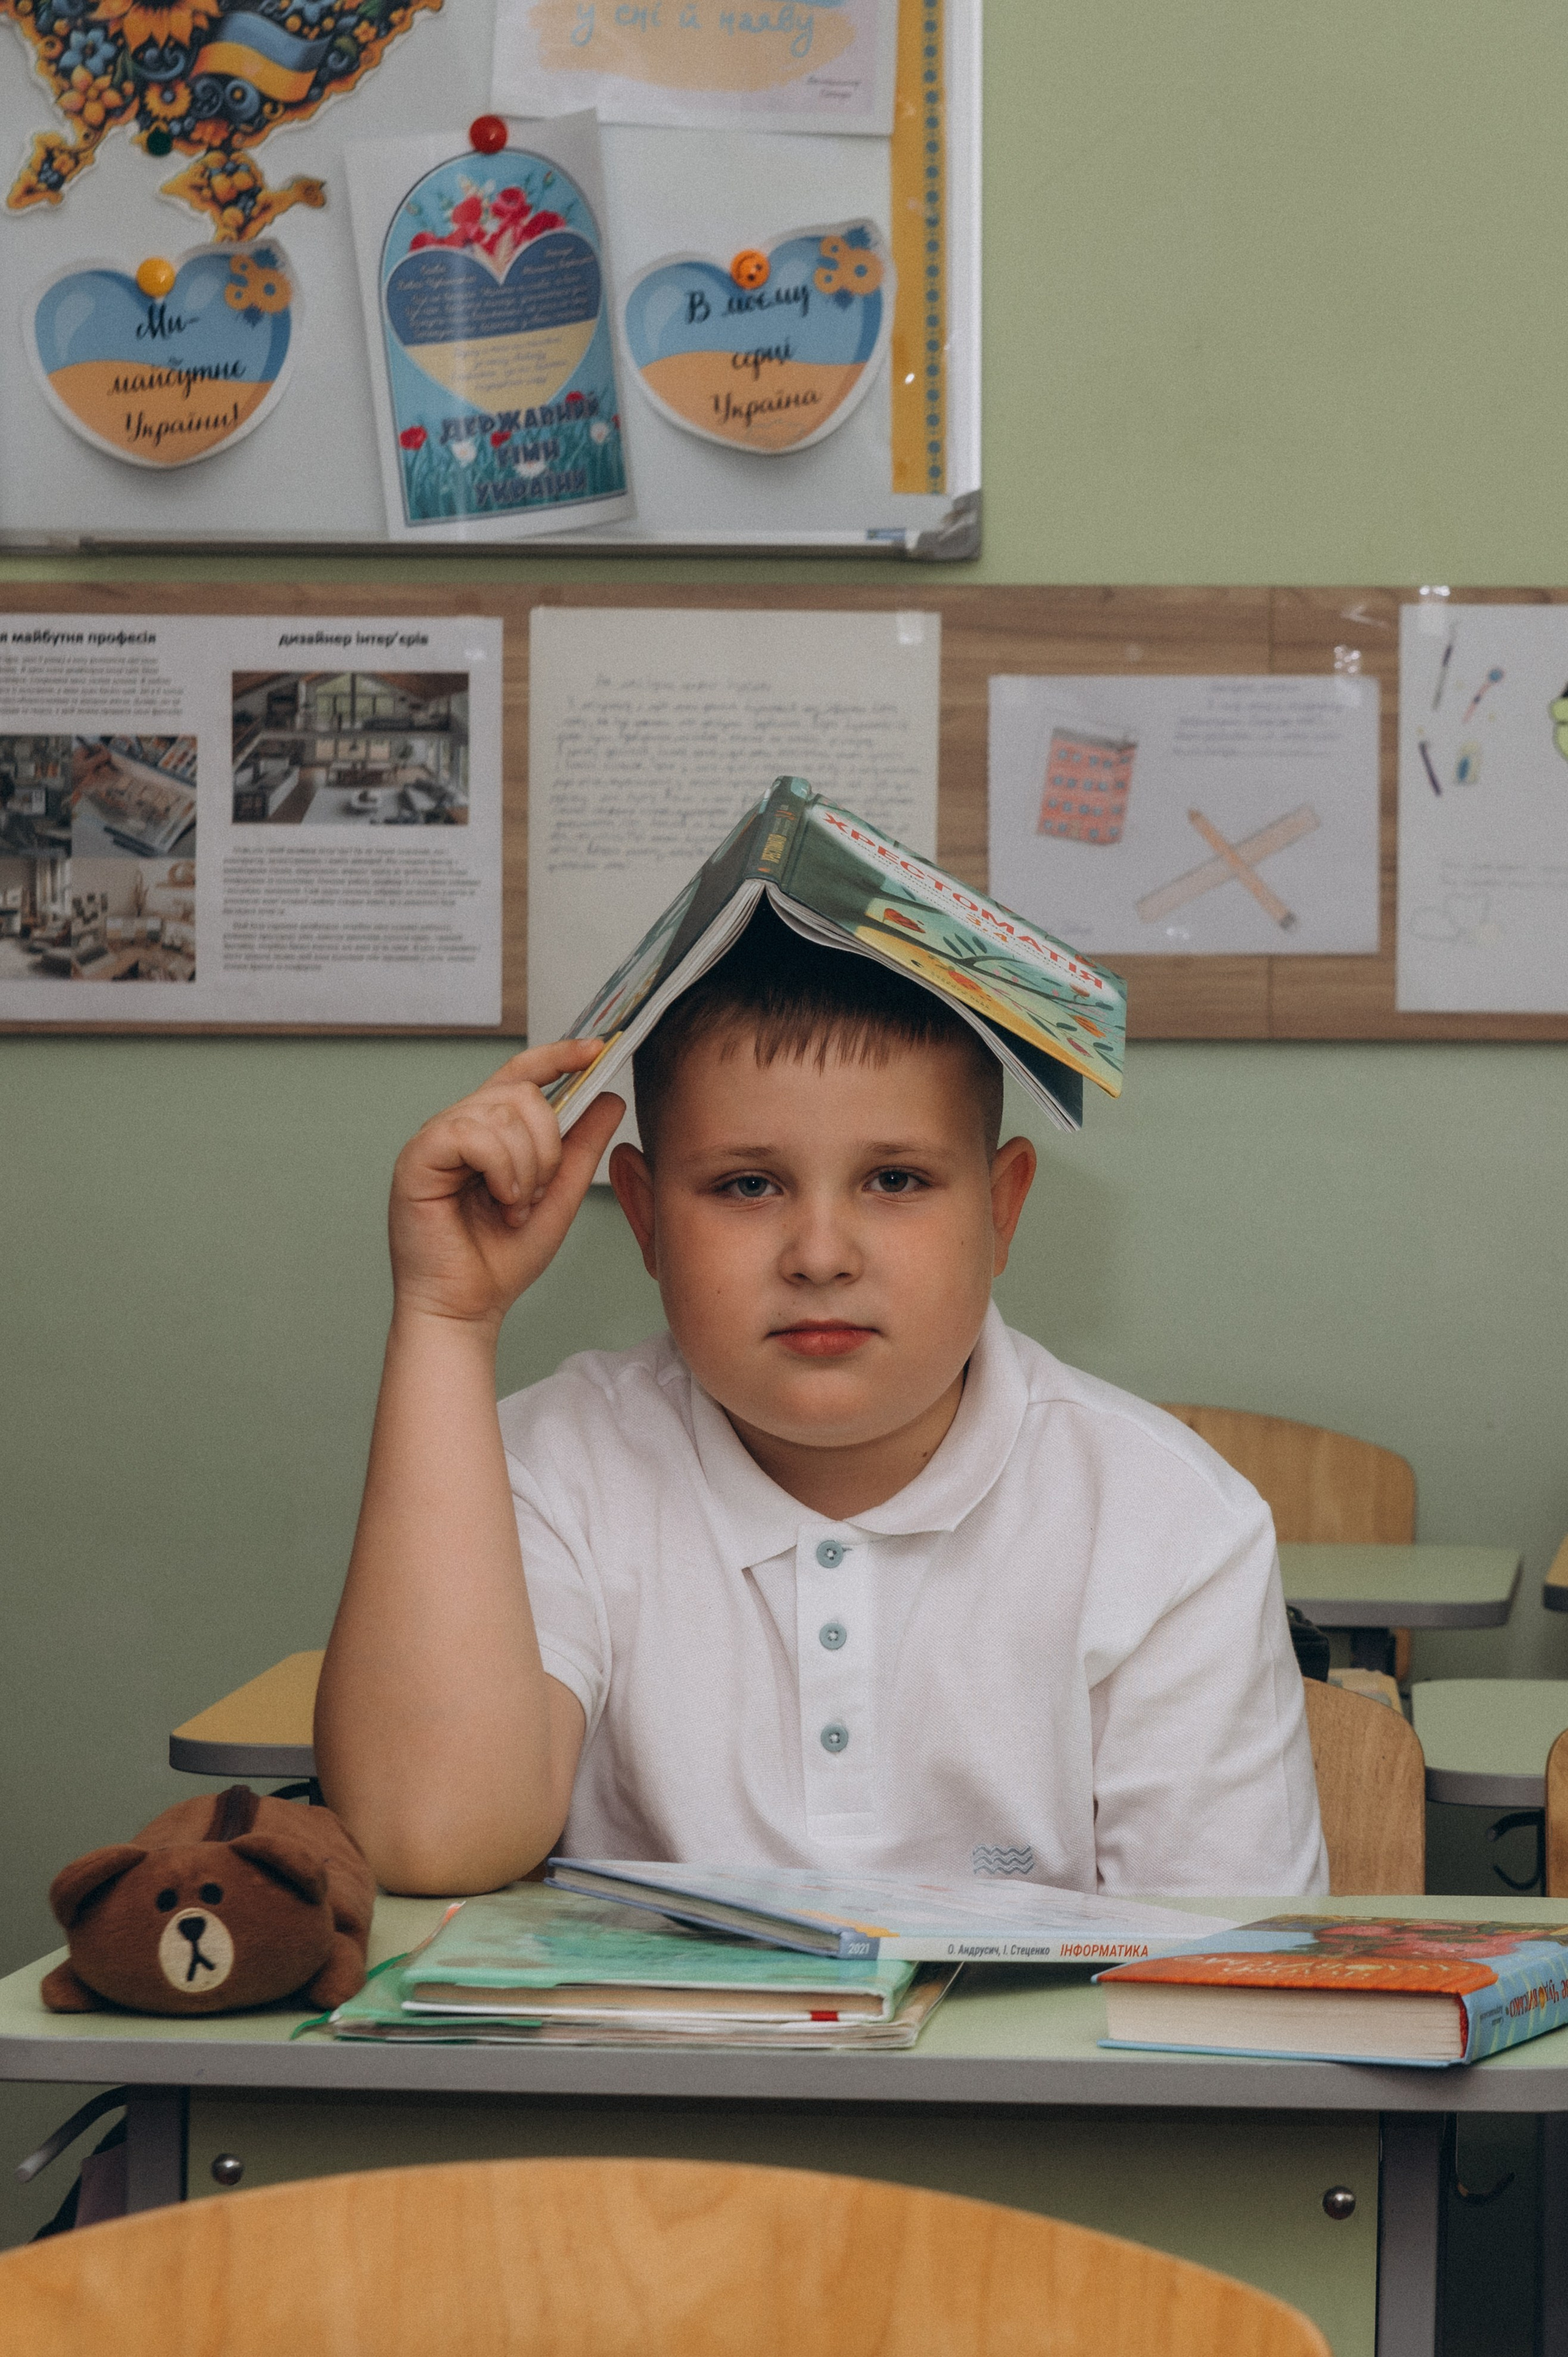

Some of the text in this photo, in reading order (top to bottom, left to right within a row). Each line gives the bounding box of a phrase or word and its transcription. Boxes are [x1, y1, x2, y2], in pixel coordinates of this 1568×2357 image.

[571, 2, 595, 47] у
[614, 1, 662, 32] сні
[718, 4, 815, 58] наяву
[685, 285, 810, 324] В моєму
[732, 338, 793, 381] серці
[126, 401, 238, 447] України!
[440, 391, 599, 445] ДЕРЖАВНИЙ
[709, 390, 821, 427] Україна
[475, 464, 586, 506] УКРАЇНИ
[12, 628, 83, 647] майбутня
[88, 629, 156, 647] професія
[279, 629, 353, 648] дизайнер
[823, 812, 1102, 989] ХРЕСТОМАТІЯ
[993, 932, 1009, 943] 4
[848, 1942, 870, 1956] 2021
[948, 1944, 956, 1955] О.
[958, 1944, 1001, 1958] Андрусич,
[1011, 1944, 1050, 1957] Стеценко
[1060, 1943, 1149, 1958] ІНФОРМАТИКА
